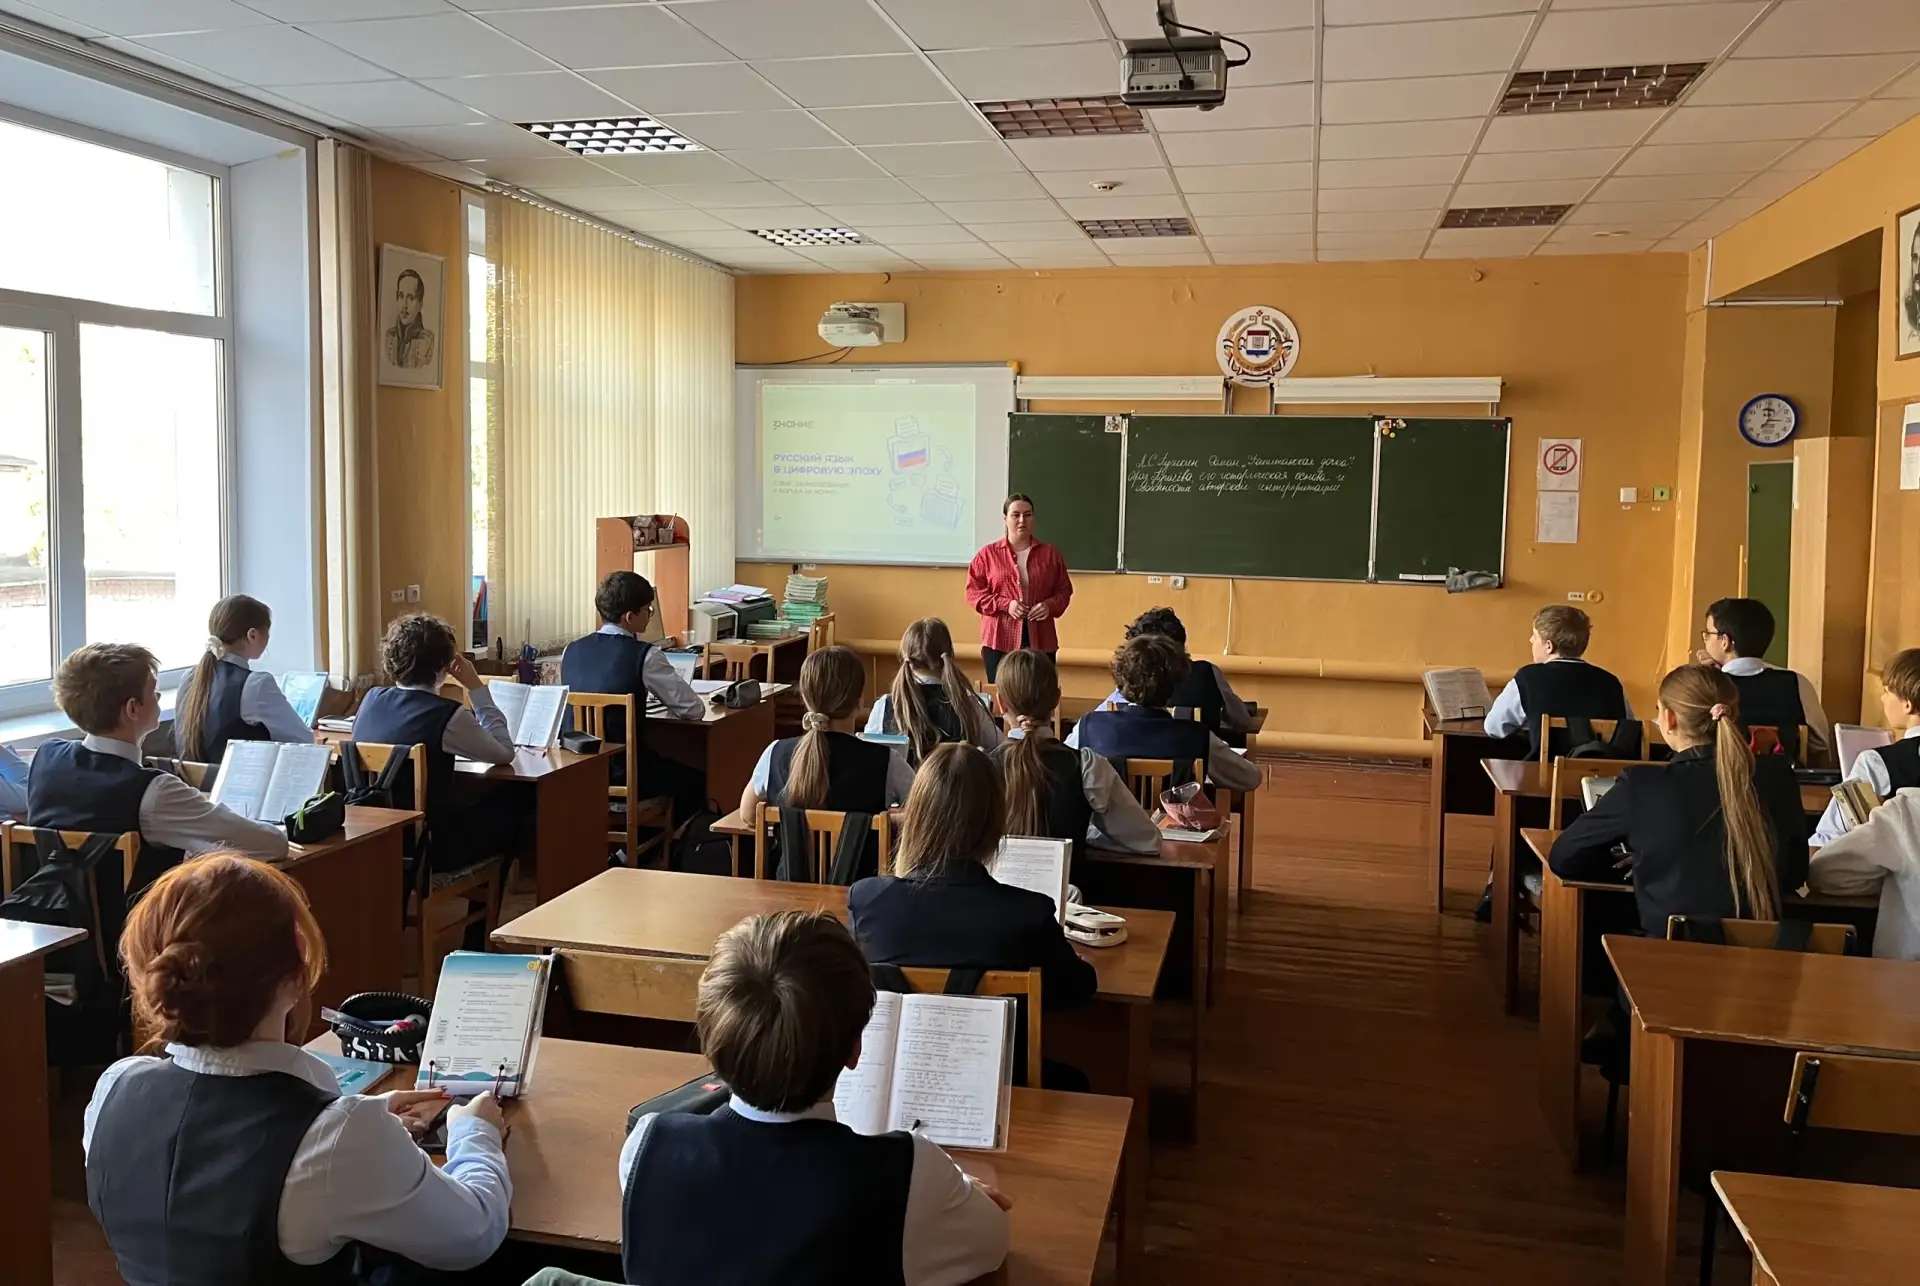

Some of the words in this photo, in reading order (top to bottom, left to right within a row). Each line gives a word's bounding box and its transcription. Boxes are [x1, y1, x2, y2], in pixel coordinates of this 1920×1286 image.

[773, 453, 821, 463] РУССКИЙ
[824, 455, 855, 463] ЯЗЫК
[773, 465, 781, 474] В
[784, 466, 844, 476] ЦИФРОВУЮ
[847, 467, 883, 476] ЭПОХУ
